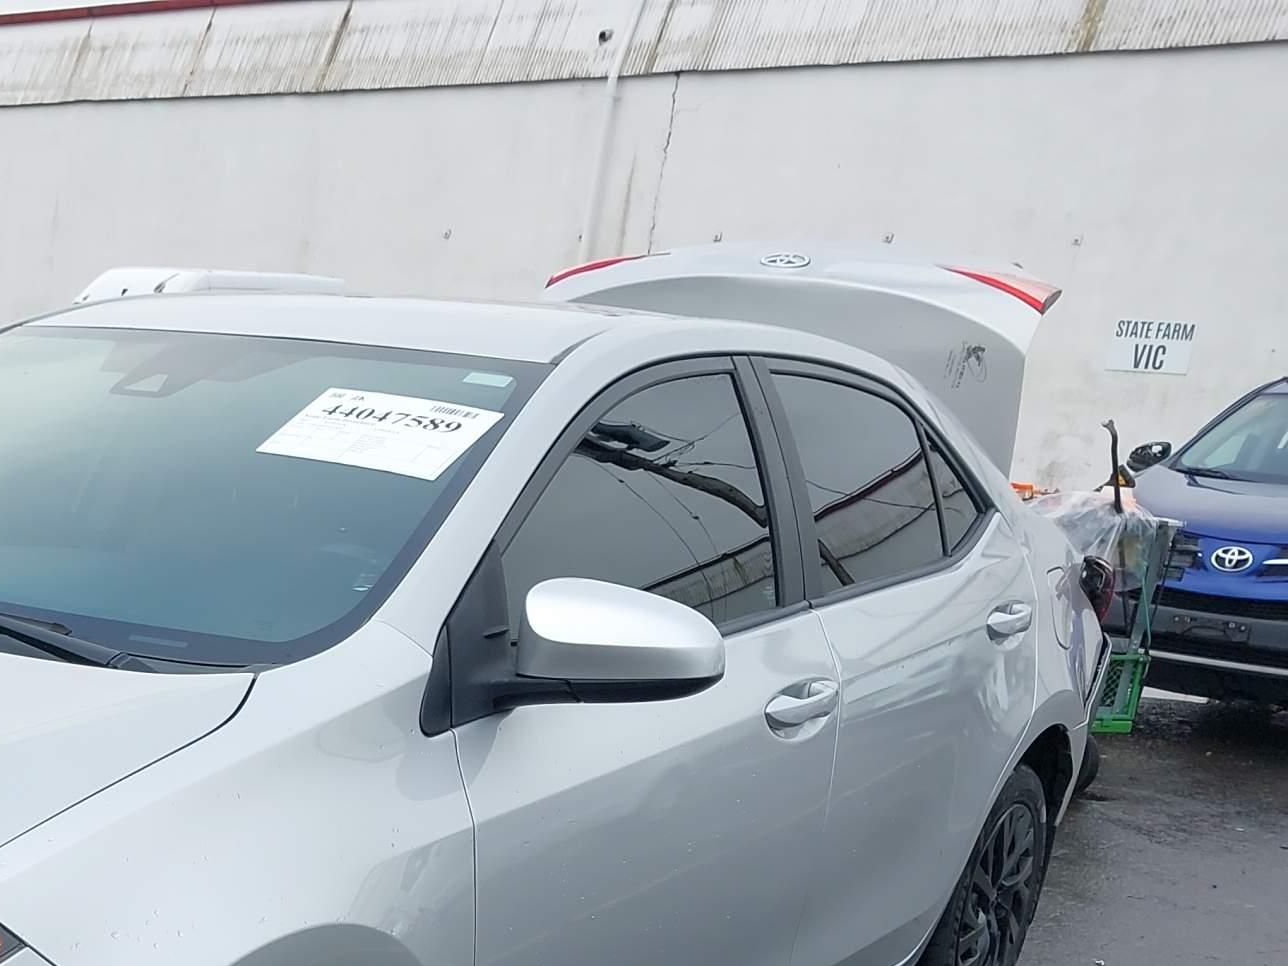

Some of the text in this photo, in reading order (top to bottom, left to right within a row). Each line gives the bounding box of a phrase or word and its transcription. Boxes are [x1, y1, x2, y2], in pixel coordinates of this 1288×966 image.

[1115, 320, 1195, 341] STATE FARM
[1133, 343, 1166, 370] VIC
[321, 404, 462, 433] 44047589
